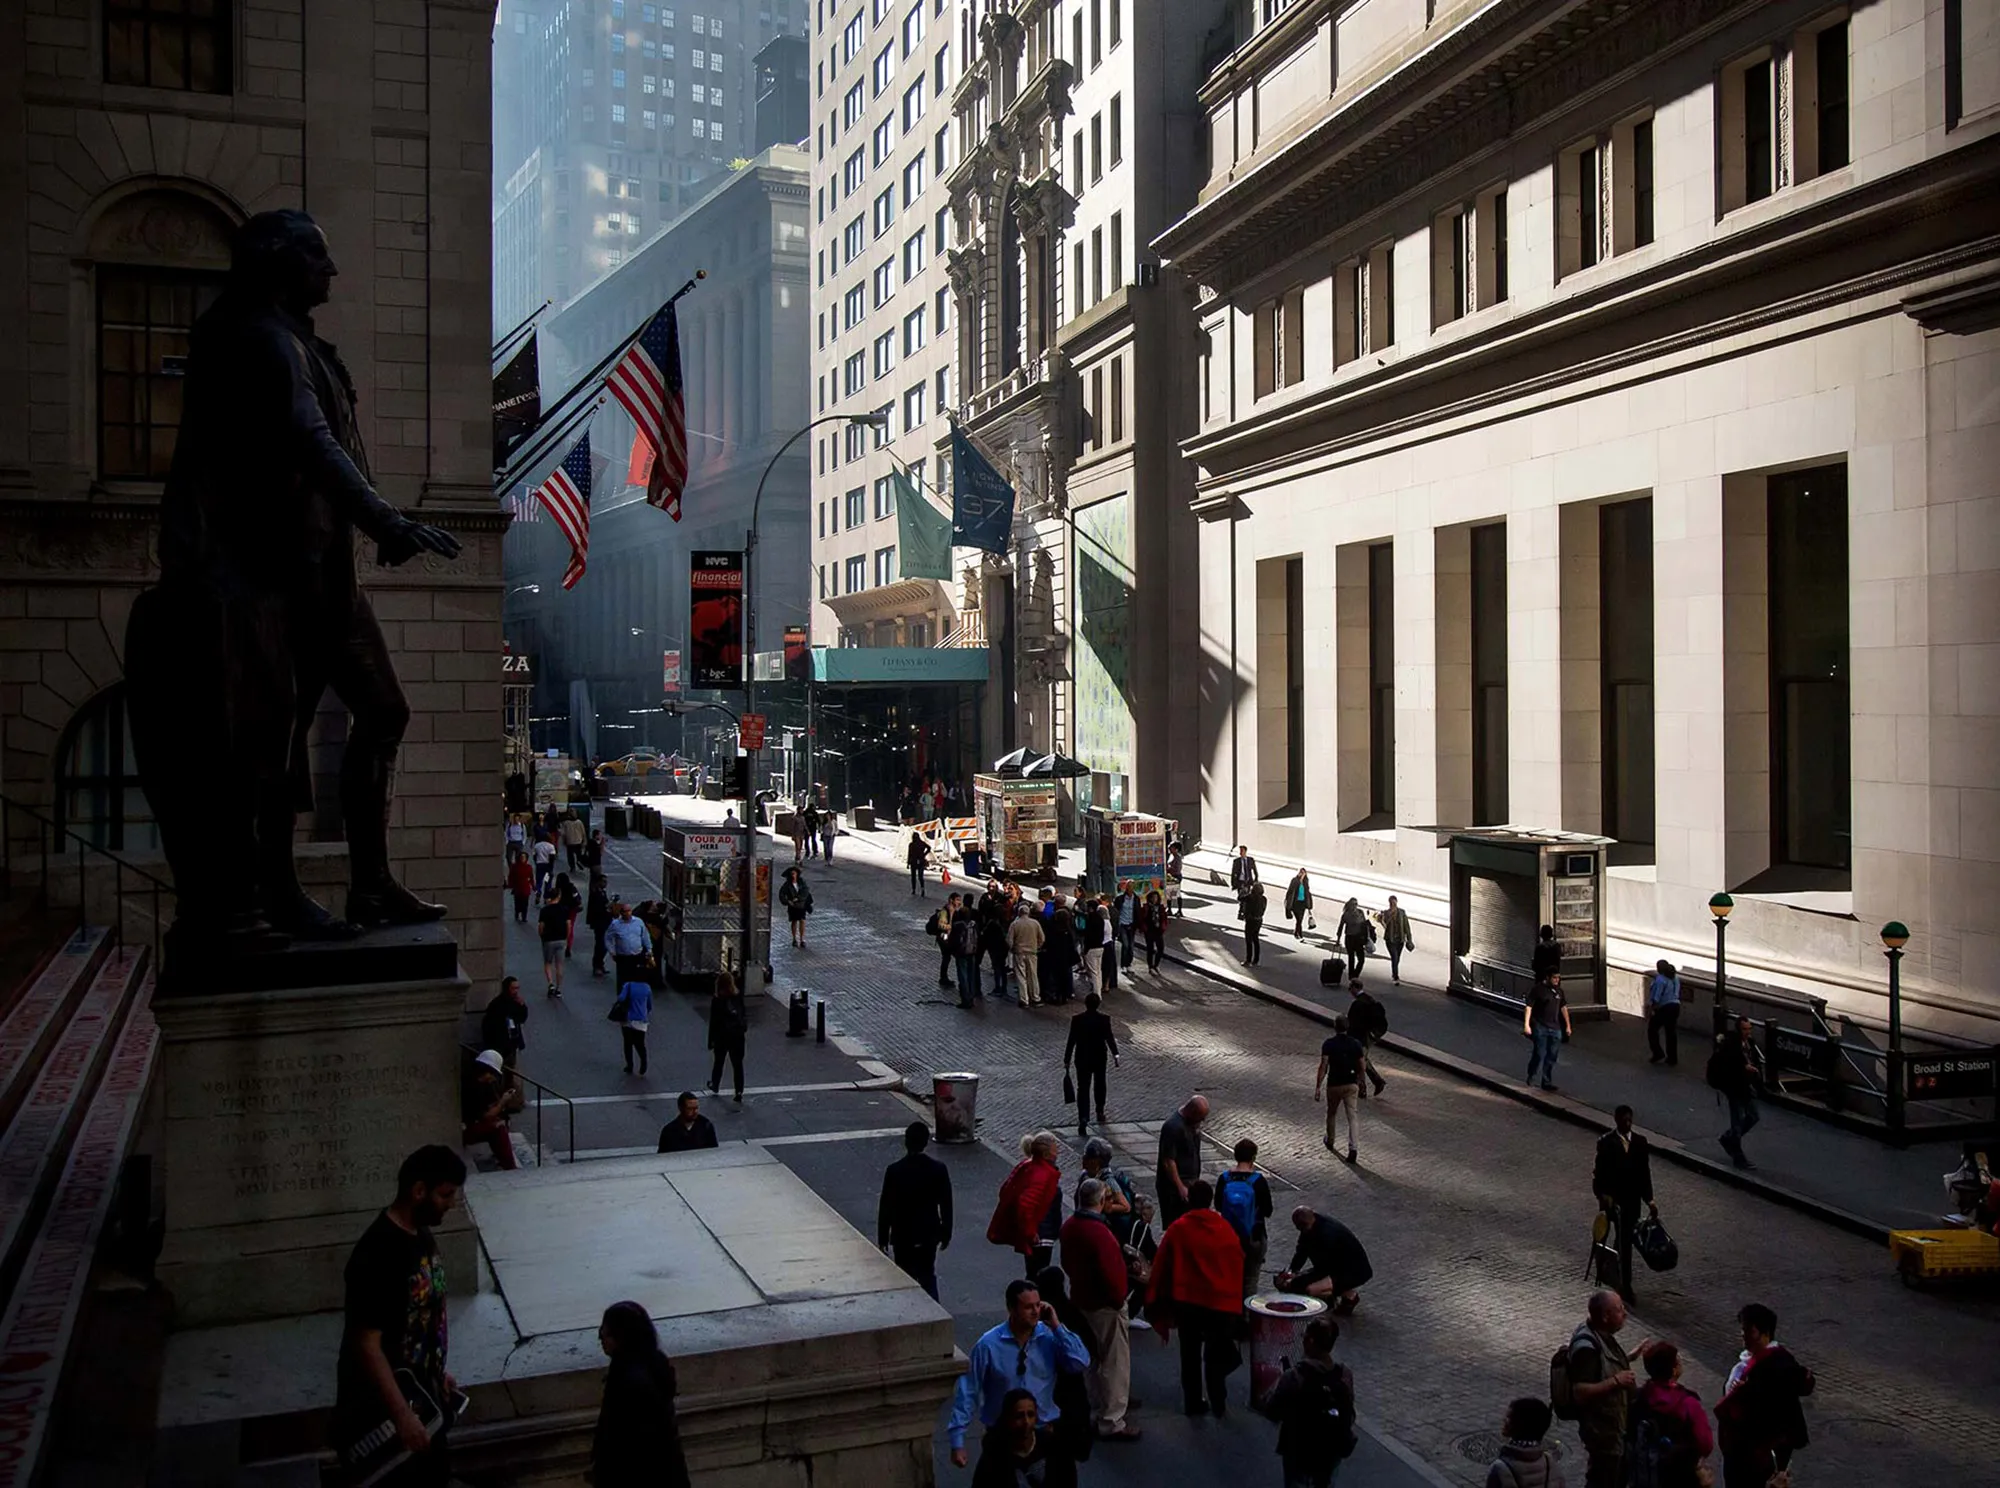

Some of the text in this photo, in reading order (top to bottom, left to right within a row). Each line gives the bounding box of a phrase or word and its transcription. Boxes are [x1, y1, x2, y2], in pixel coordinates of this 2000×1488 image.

[961, 493, 1005, 530] 37
[705, 556, 729, 566] NYC
[691, 570, 742, 583] financial
[709, 668, 726, 680] bgc
[688, 835, 731, 844] YOUR AD
[1775, 1035, 1812, 1060] Subway
[1913, 1060, 1991, 1075] Broad St Station
[4, 1301, 67, 1350] FIRST
